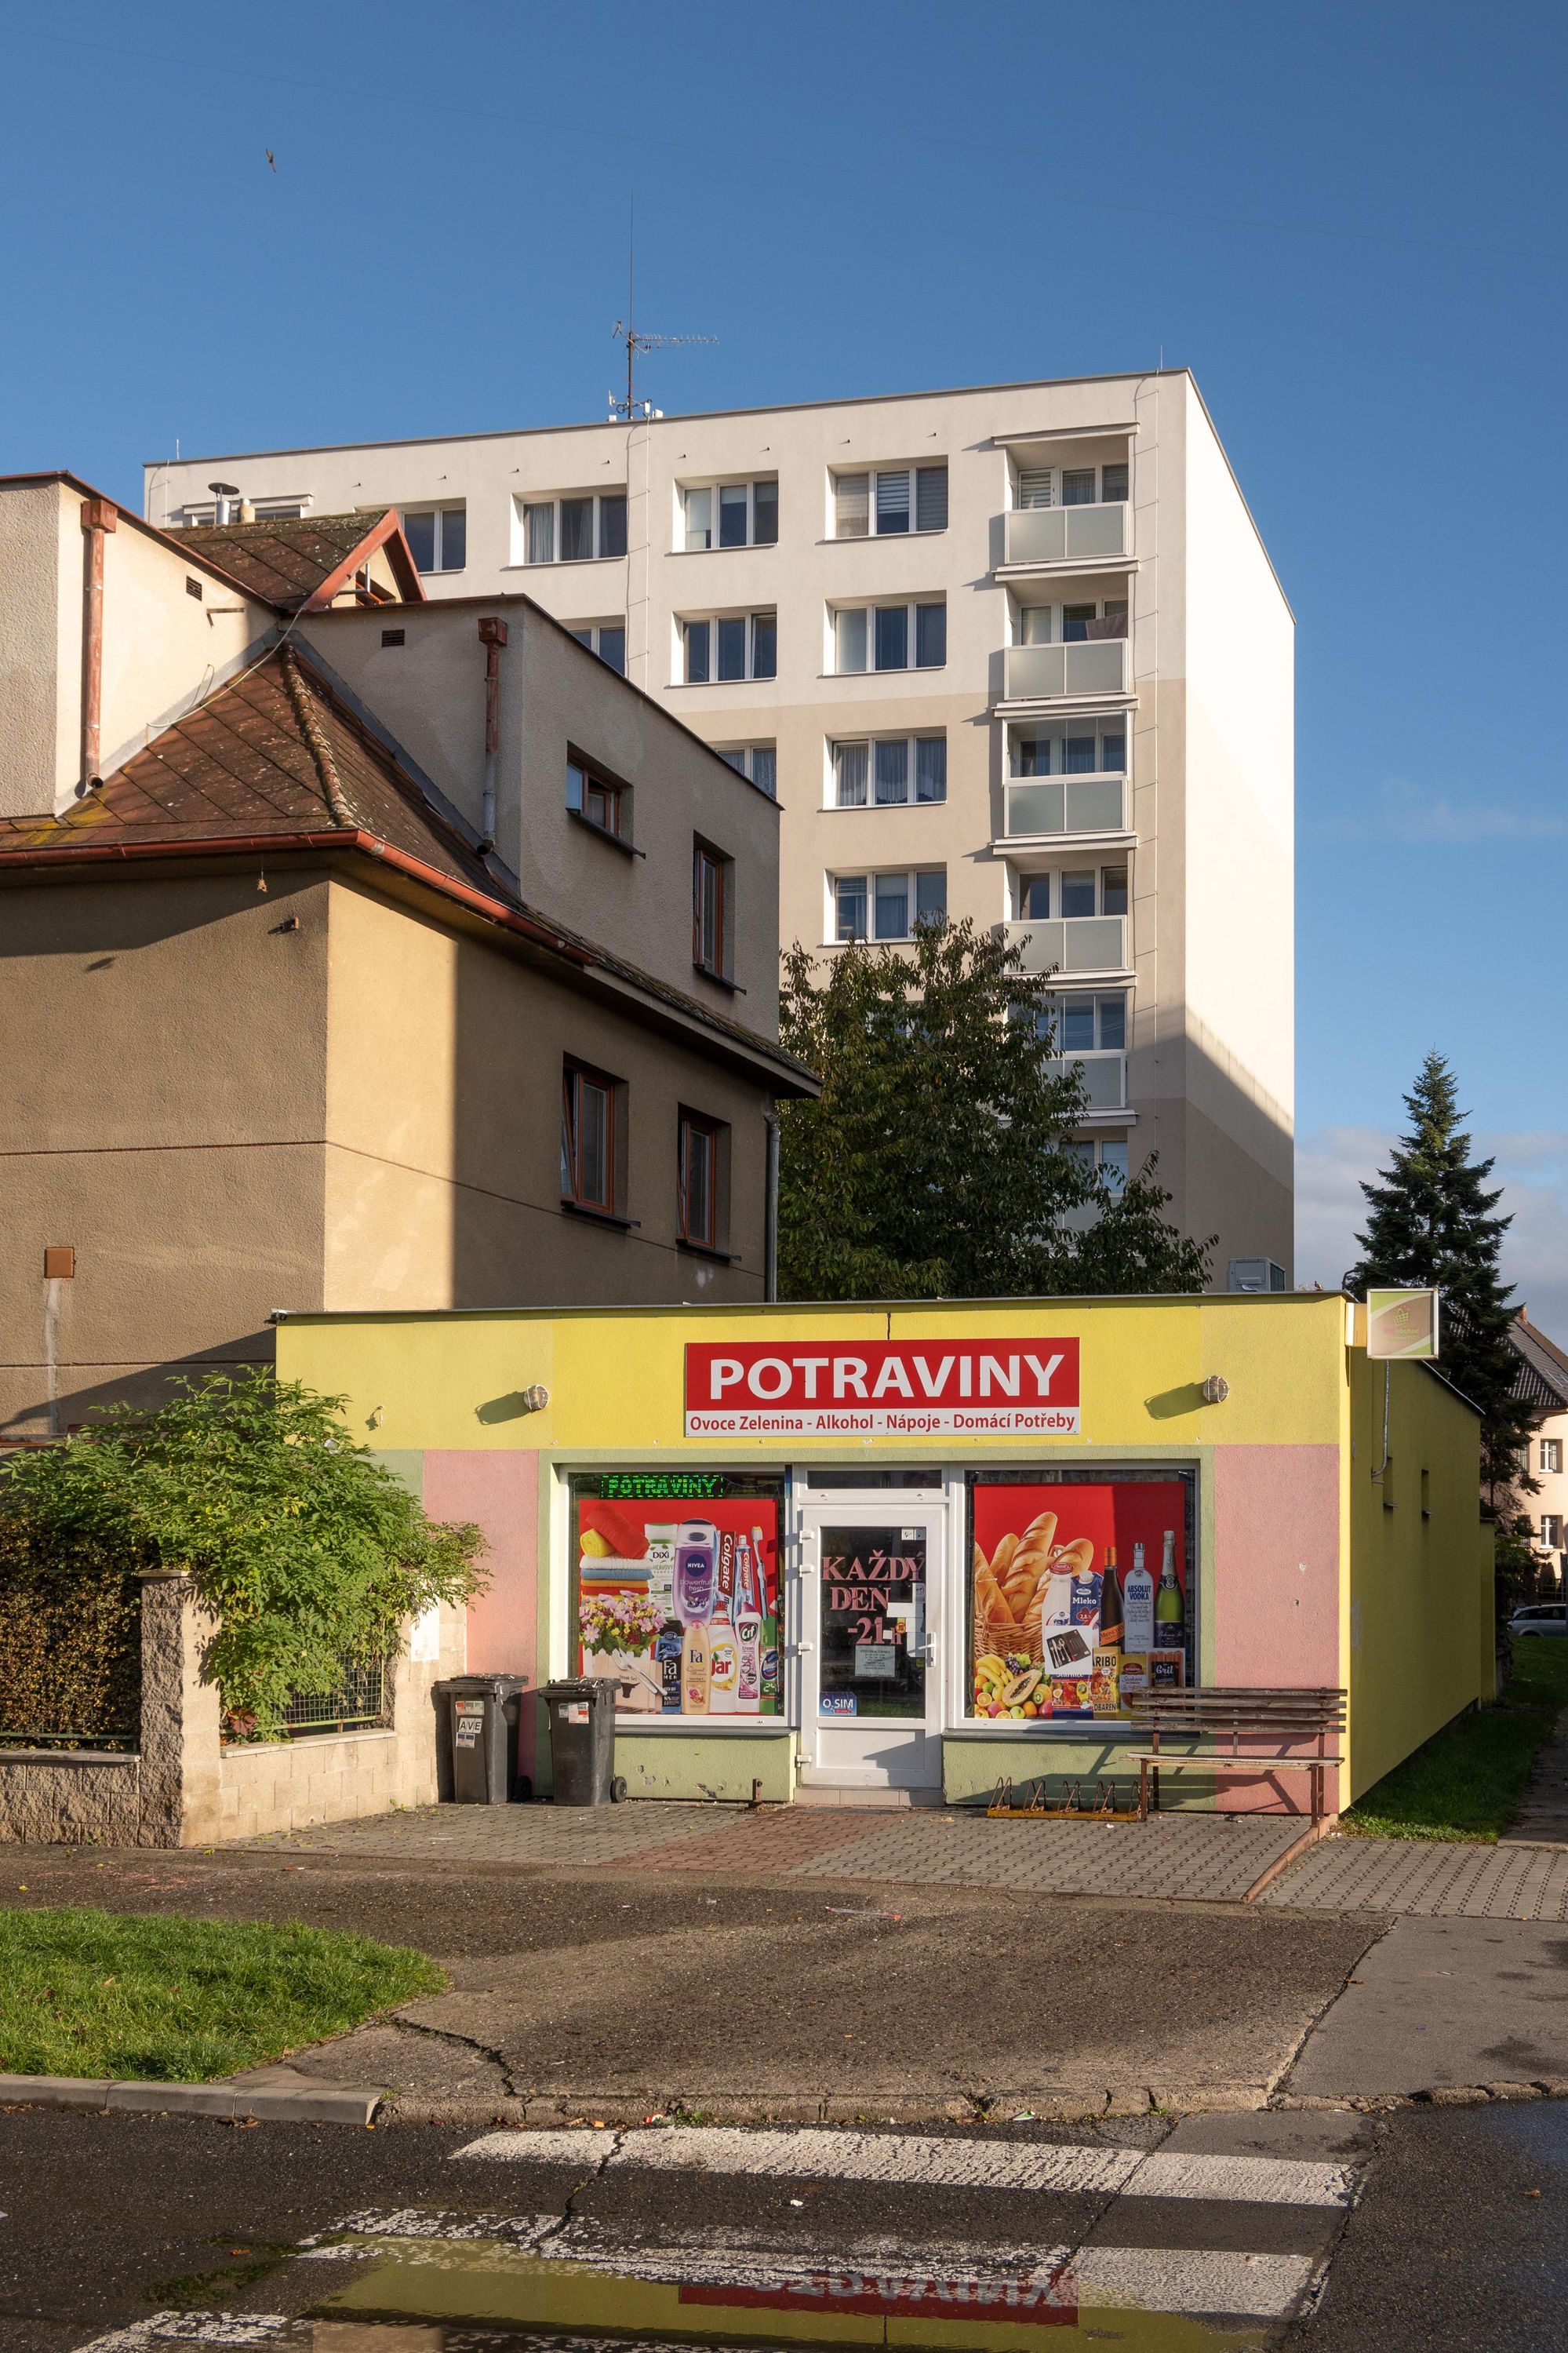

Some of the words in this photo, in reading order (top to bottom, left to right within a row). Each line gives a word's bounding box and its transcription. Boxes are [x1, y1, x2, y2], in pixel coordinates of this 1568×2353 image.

[710, 1354, 1064, 1400] POTRAVINY
[690, 1416, 736, 1430] Ovoce
[740, 1415, 803, 1430] Zelenina
[816, 1415, 873, 1430] Alkohol
[886, 1413, 940, 1432] Nápoje
[954, 1412, 1011, 1428] Domácí
[1015, 1411, 1075, 1431] Potřeby
[722, 1534, 732, 1589] Colgate
[821, 1550, 924, 1581] KAŽDÝ
[830, 1586, 890, 1612] DEN
[742, 1626, 755, 1640] Cif
[690, 1650, 703, 1663] Fa
[1093, 1656, 1116, 1667] RIBO
[664, 1659, 677, 1675] Fa
[711, 1659, 731, 1677] Jar
[1156, 1665, 1174, 1674] Gril
[835, 1699, 853, 1709] SIM
[460, 1720, 481, 1731] AVE
